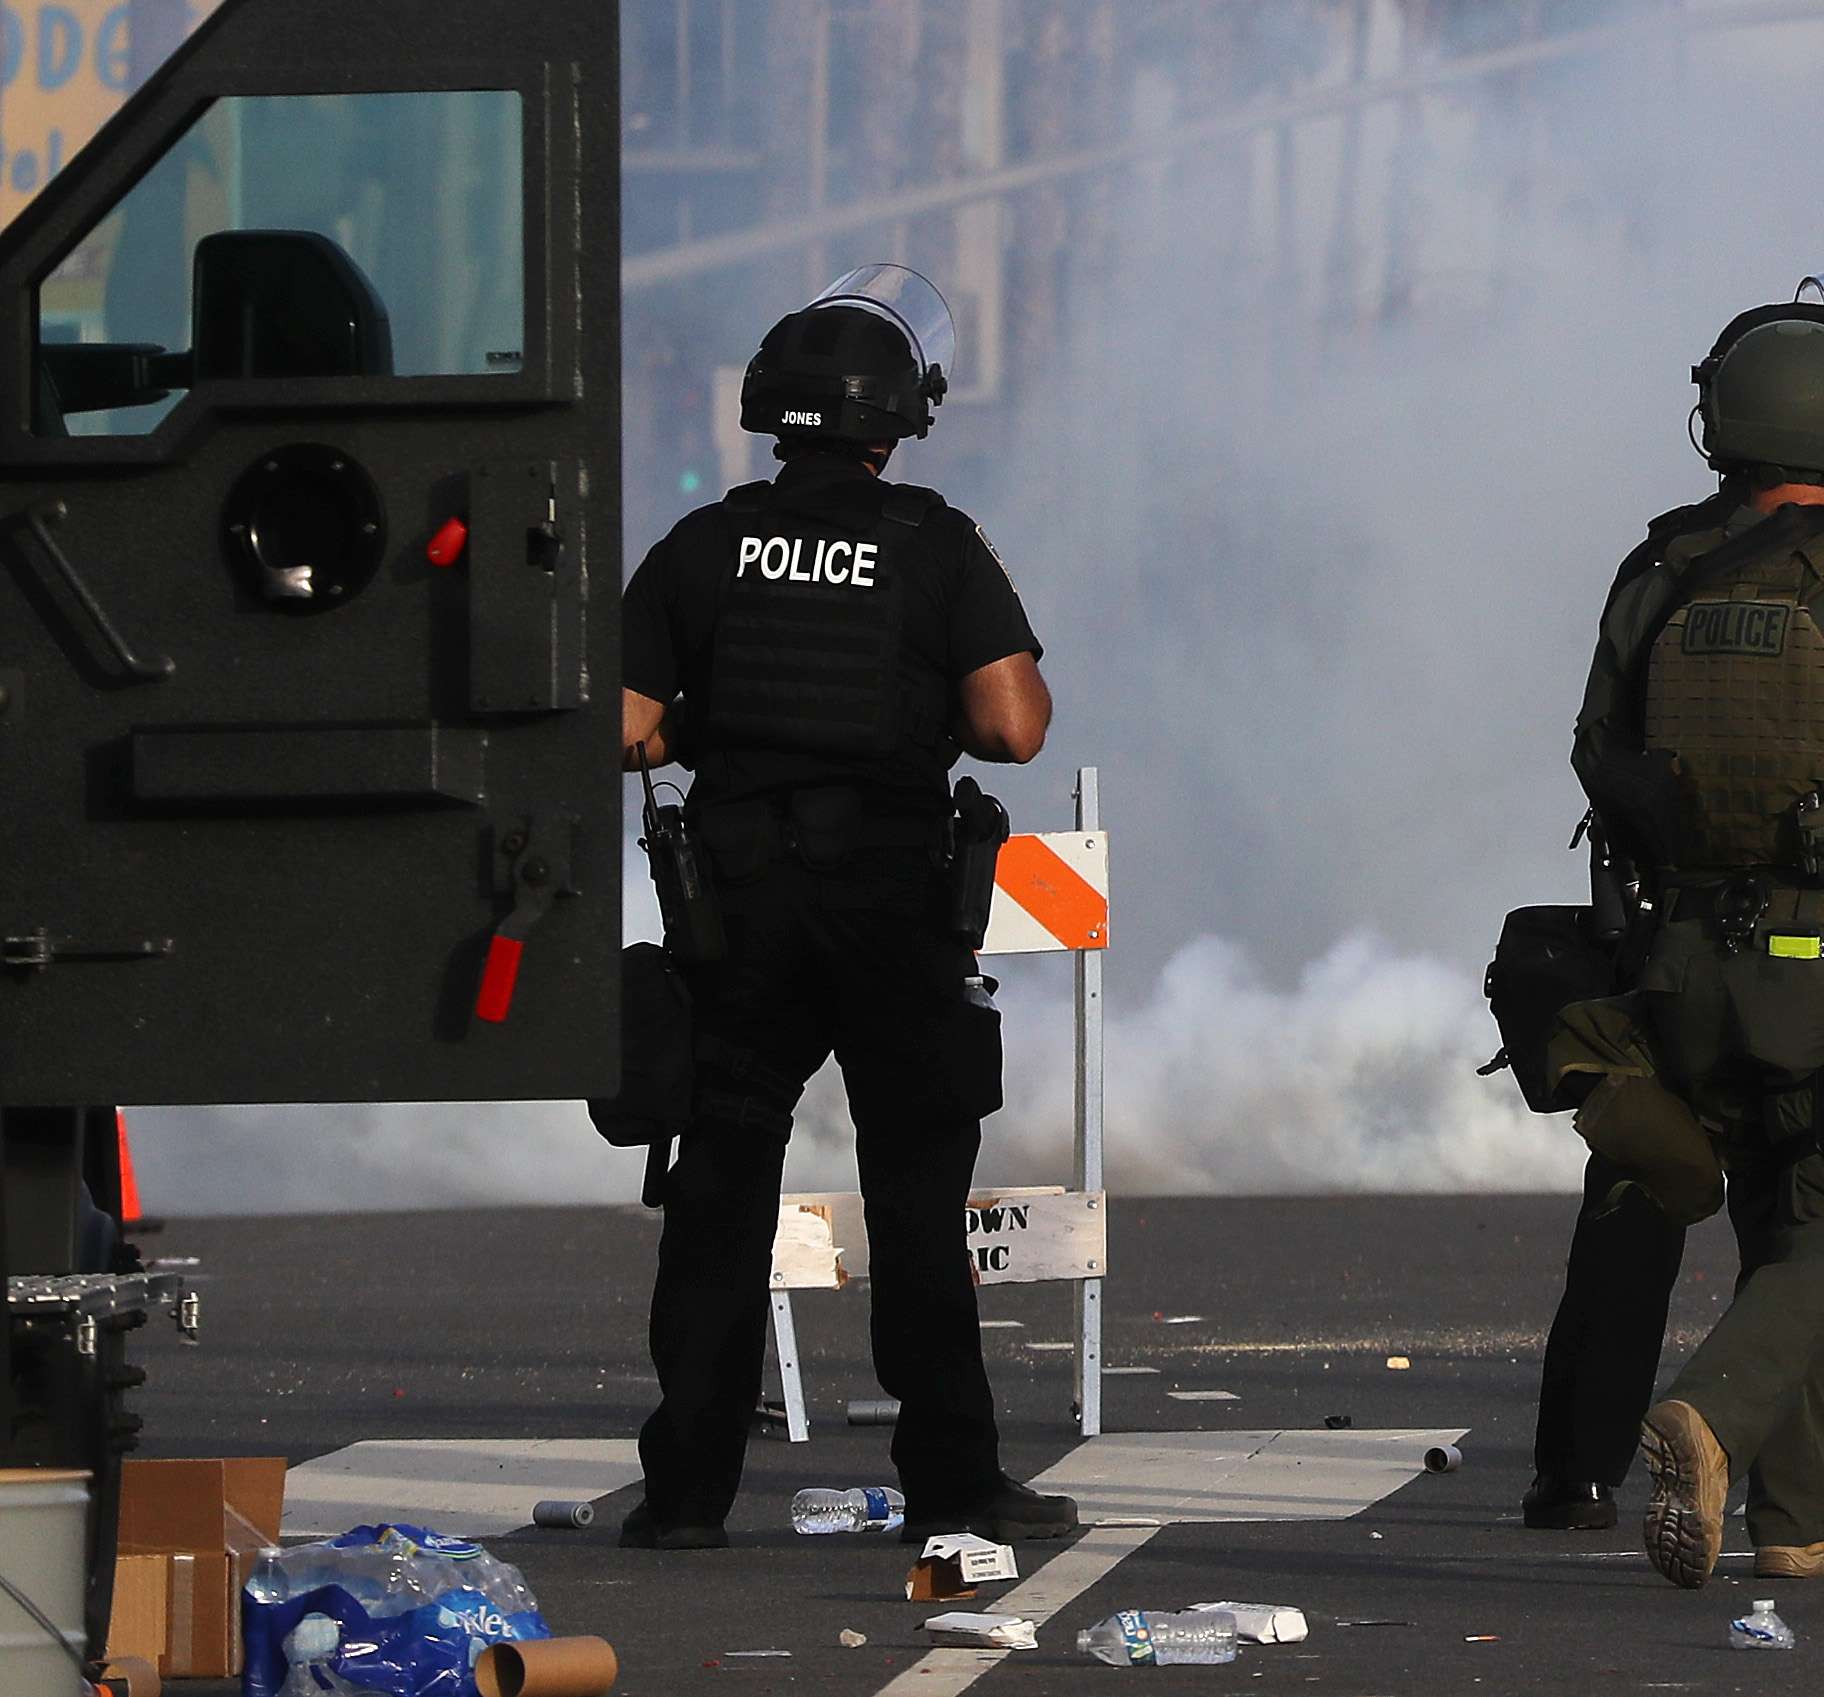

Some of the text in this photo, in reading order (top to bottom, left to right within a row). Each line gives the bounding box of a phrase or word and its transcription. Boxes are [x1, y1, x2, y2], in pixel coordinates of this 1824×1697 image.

[781, 410, 822, 426] JONES
[736, 536, 878, 587] POLICE
[1688, 605, 1780, 650] POLICE
[966, 1205, 1030, 1234] OWN
